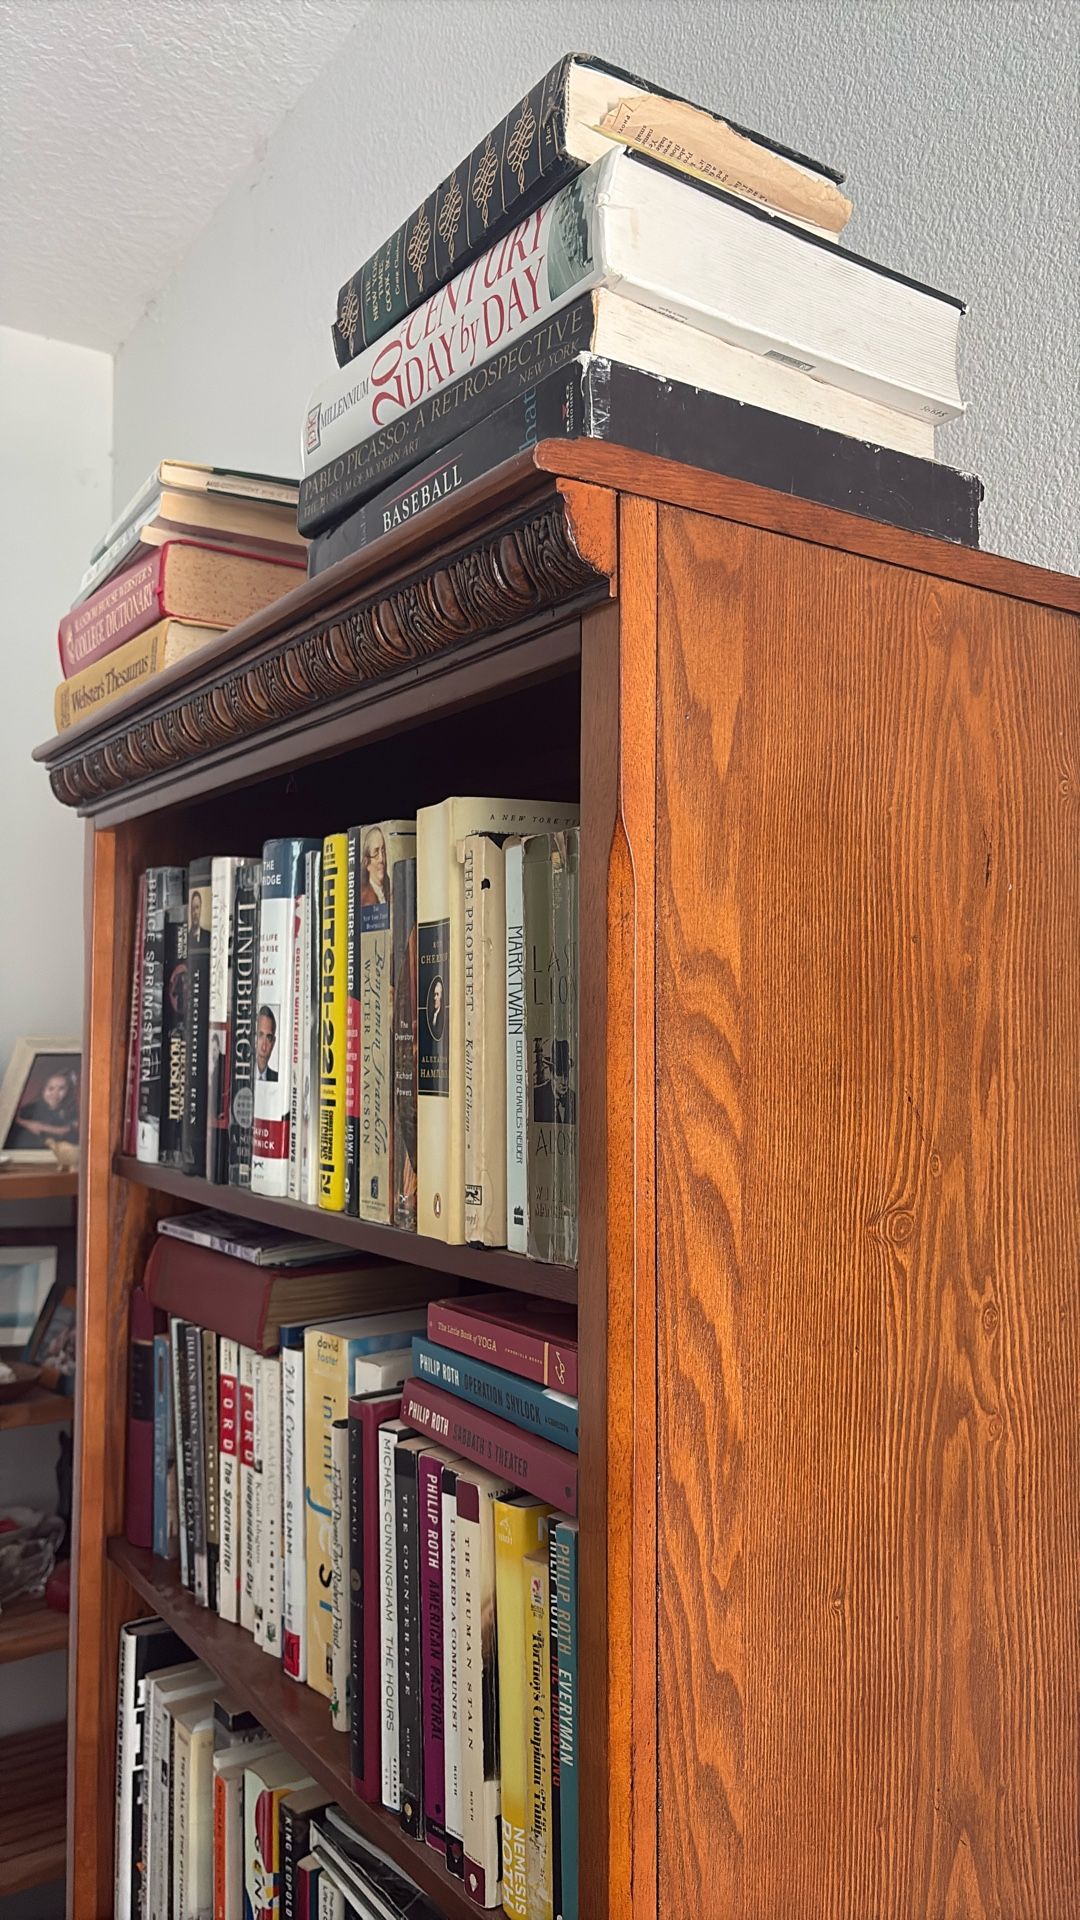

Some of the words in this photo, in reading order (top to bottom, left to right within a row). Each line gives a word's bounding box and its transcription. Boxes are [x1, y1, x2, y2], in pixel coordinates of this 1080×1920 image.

[371, 253, 380, 288] YORK
[384, 273, 392, 312] COOK
[405, 199, 551, 350] CENTURY
[371, 291, 380, 321] NEW
[403, 324, 457, 406] DAY
[459, 314, 480, 367] by
[482, 255, 545, 349] DAY
[518, 364, 544, 387] NEW
[549, 340, 581, 367] YORK
[303, 460, 345, 501] PABLO
[347, 421, 410, 475] PICASSO:
[414, 408, 425, 433] A
[431, 305, 584, 424] RETROSPECTIVE
[320, 377, 369, 430] MILLENNIUM
[402, 438, 420, 457] ART
[382, 464, 463, 534] BASEBALL
[74, 618, 106, 662] COLLEGE
[106, 581, 155, 638] DICTIONARY
[99, 589, 120, 613] HOUSE
[71, 680, 106, 713] Webster's
[105, 655, 149, 695] Thesaurus
[502, 814, 526, 822] NEW
[532, 816, 559, 825] YORK
[263, 859, 275, 871] THE
[347, 837, 356, 865] THE
[464, 850, 474, 900] THE
[145, 880, 157, 942] BRUCE
[347, 871, 356, 937] BROTHERS
[321, 877, 335, 1076] HITCH-22
[347, 942, 356, 991] BULGER
[464, 905, 474, 1012] PROPHET
[508, 925, 524, 973] MARK
[141, 950, 155, 1082] SPRINGSTEEN
[235, 901, 257, 1080] LINDBERGH
[363, 959, 371, 1034] WALTER
[371, 938, 387, 1051] Benjamin
[508, 977, 524, 1035] TWAIN
[191, 969, 200, 1078] THEODORE
[293, 997, 301, 1064] WHITEHEAD
[395, 1033, 414, 1044] Overstory
[400, 1021, 409, 1029] The
[168, 1037, 181, 1122] ROOSEVELT
[396, 1071, 412, 1080] Richard
[465, 1038, 474, 1080] Kahlil
[516, 1074, 523, 1087] BY
[189, 1087, 199, 1126] REX
[363, 1046, 371, 1144] ISAACSON
[373, 1050, 388, 1156] Franklin
[396, 1089, 412, 1097] Powers
[465, 1083, 474, 1132] Gibran
[321, 1109, 329, 1160] HITCHENS
[186, 1335, 196, 1381] JULIAN
[317, 1336, 339, 1352] david
[317, 1353, 339, 1366] foster
[438, 1321, 447, 1331] The
[447, 1325, 460, 1337] Little
[460, 1328, 473, 1340] Book
[472, 1333, 478, 1343] of
[477, 1335, 497, 1352] YOGA
[284, 1362, 295, 1379] J.
[285, 1384, 295, 1408] M.
[419, 1353, 441, 1376] PHILIP
[442, 1363, 460, 1386] ROTH
[463, 1373, 504, 1404] OPERATION
[505, 1392, 541, 1425] SHYLOCK
[188, 1384, 197, 1435] BARNES
[222, 1378, 235, 1451] FORD
[244, 1391, 254, 1461] FORD
[408, 1400, 431, 1425] PHILIP
[430, 1411, 449, 1437] ROTH
[452, 1424, 493, 1459] SABBATH'S
[494, 1444, 529, 1478] THEATER
[185, 1438, 193, 1477] THE
[223, 1460, 233, 1484] The
[266, 1410, 277, 1506] SARAMAGO
[285, 1414, 295, 1485] Coetzee
[383, 1437, 393, 1506] MICHAEL
[186, 1487, 195, 1542] ROAD
[245, 1471, 254, 1568] Independence
[426, 1473, 439, 1525] PHILIP
[222, 1489, 234, 1575] Sportswriter
[427, 1529, 440, 1569] ROTH
[245, 1571, 254, 1599] Day
[332, 1565, 344, 1612] Robert
[385, 1511, 395, 1622] CUNNINGHAM
[449, 1528, 457, 1611] MARRIED
[556, 1544, 570, 1604] PHILIP
[402, 1544, 412, 1697] COUNTERLIFE
[429, 1579, 444, 1660] AMERICAN
[450, 1611, 458, 1623] A
[465, 1590, 473, 1670] HUMAN
[558, 1608, 572, 1656] ROTH
[385, 1636, 395, 1668] THE
[450, 1627, 458, 1732] COMMUNIST
[529, 1630, 545, 1702] Portnoy's
[385, 1672, 396, 1732] HOURS
[430, 1664, 444, 1741] PASTORAL
[466, 1682, 474, 1751] STAIN
[559, 1668, 573, 1767] EVERYMAN
[530, 1704, 547, 1785] Complaint
[284, 1815, 293, 1851] KING
[285, 1856, 294, 1918] LEOPOLD
[501, 1818, 515, 1909] ROTH
[513, 1826, 527, 1915] NEMESIS
